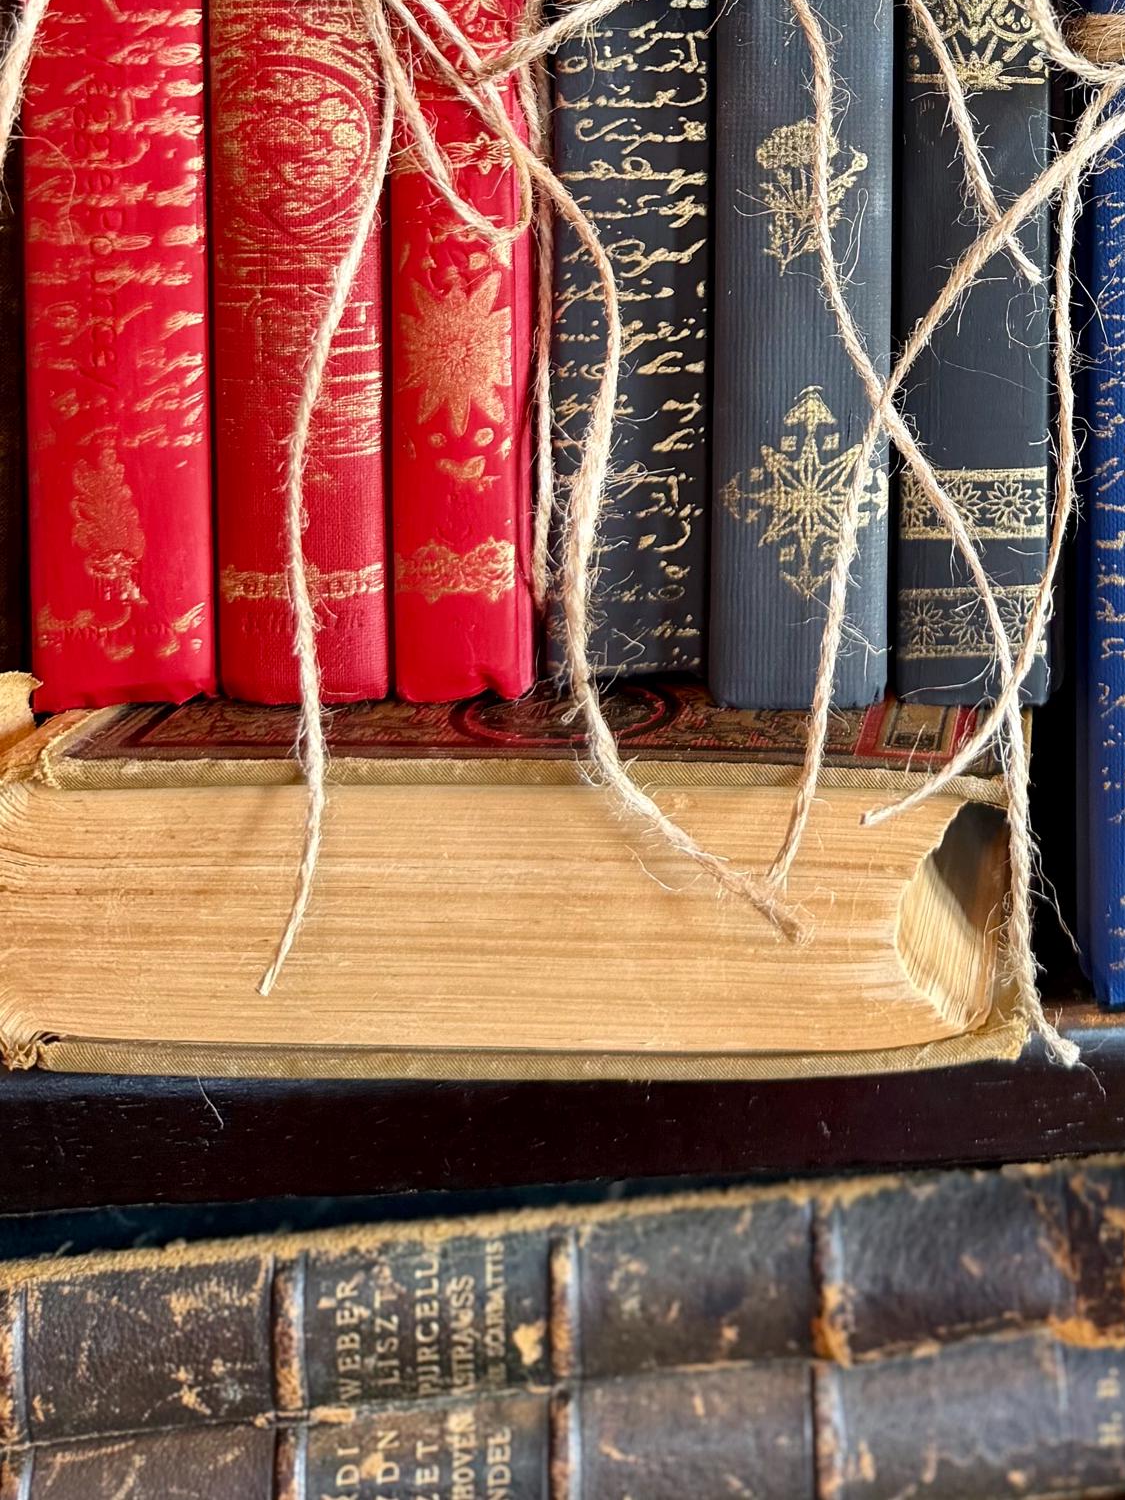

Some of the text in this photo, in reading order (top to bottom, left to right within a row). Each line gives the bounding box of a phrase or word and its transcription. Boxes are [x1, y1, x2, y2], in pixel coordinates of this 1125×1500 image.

[336, 1272, 362, 1400] WEBER
[374, 1290, 400, 1386] LISZT
[415, 1247, 441, 1397] PURCELL
